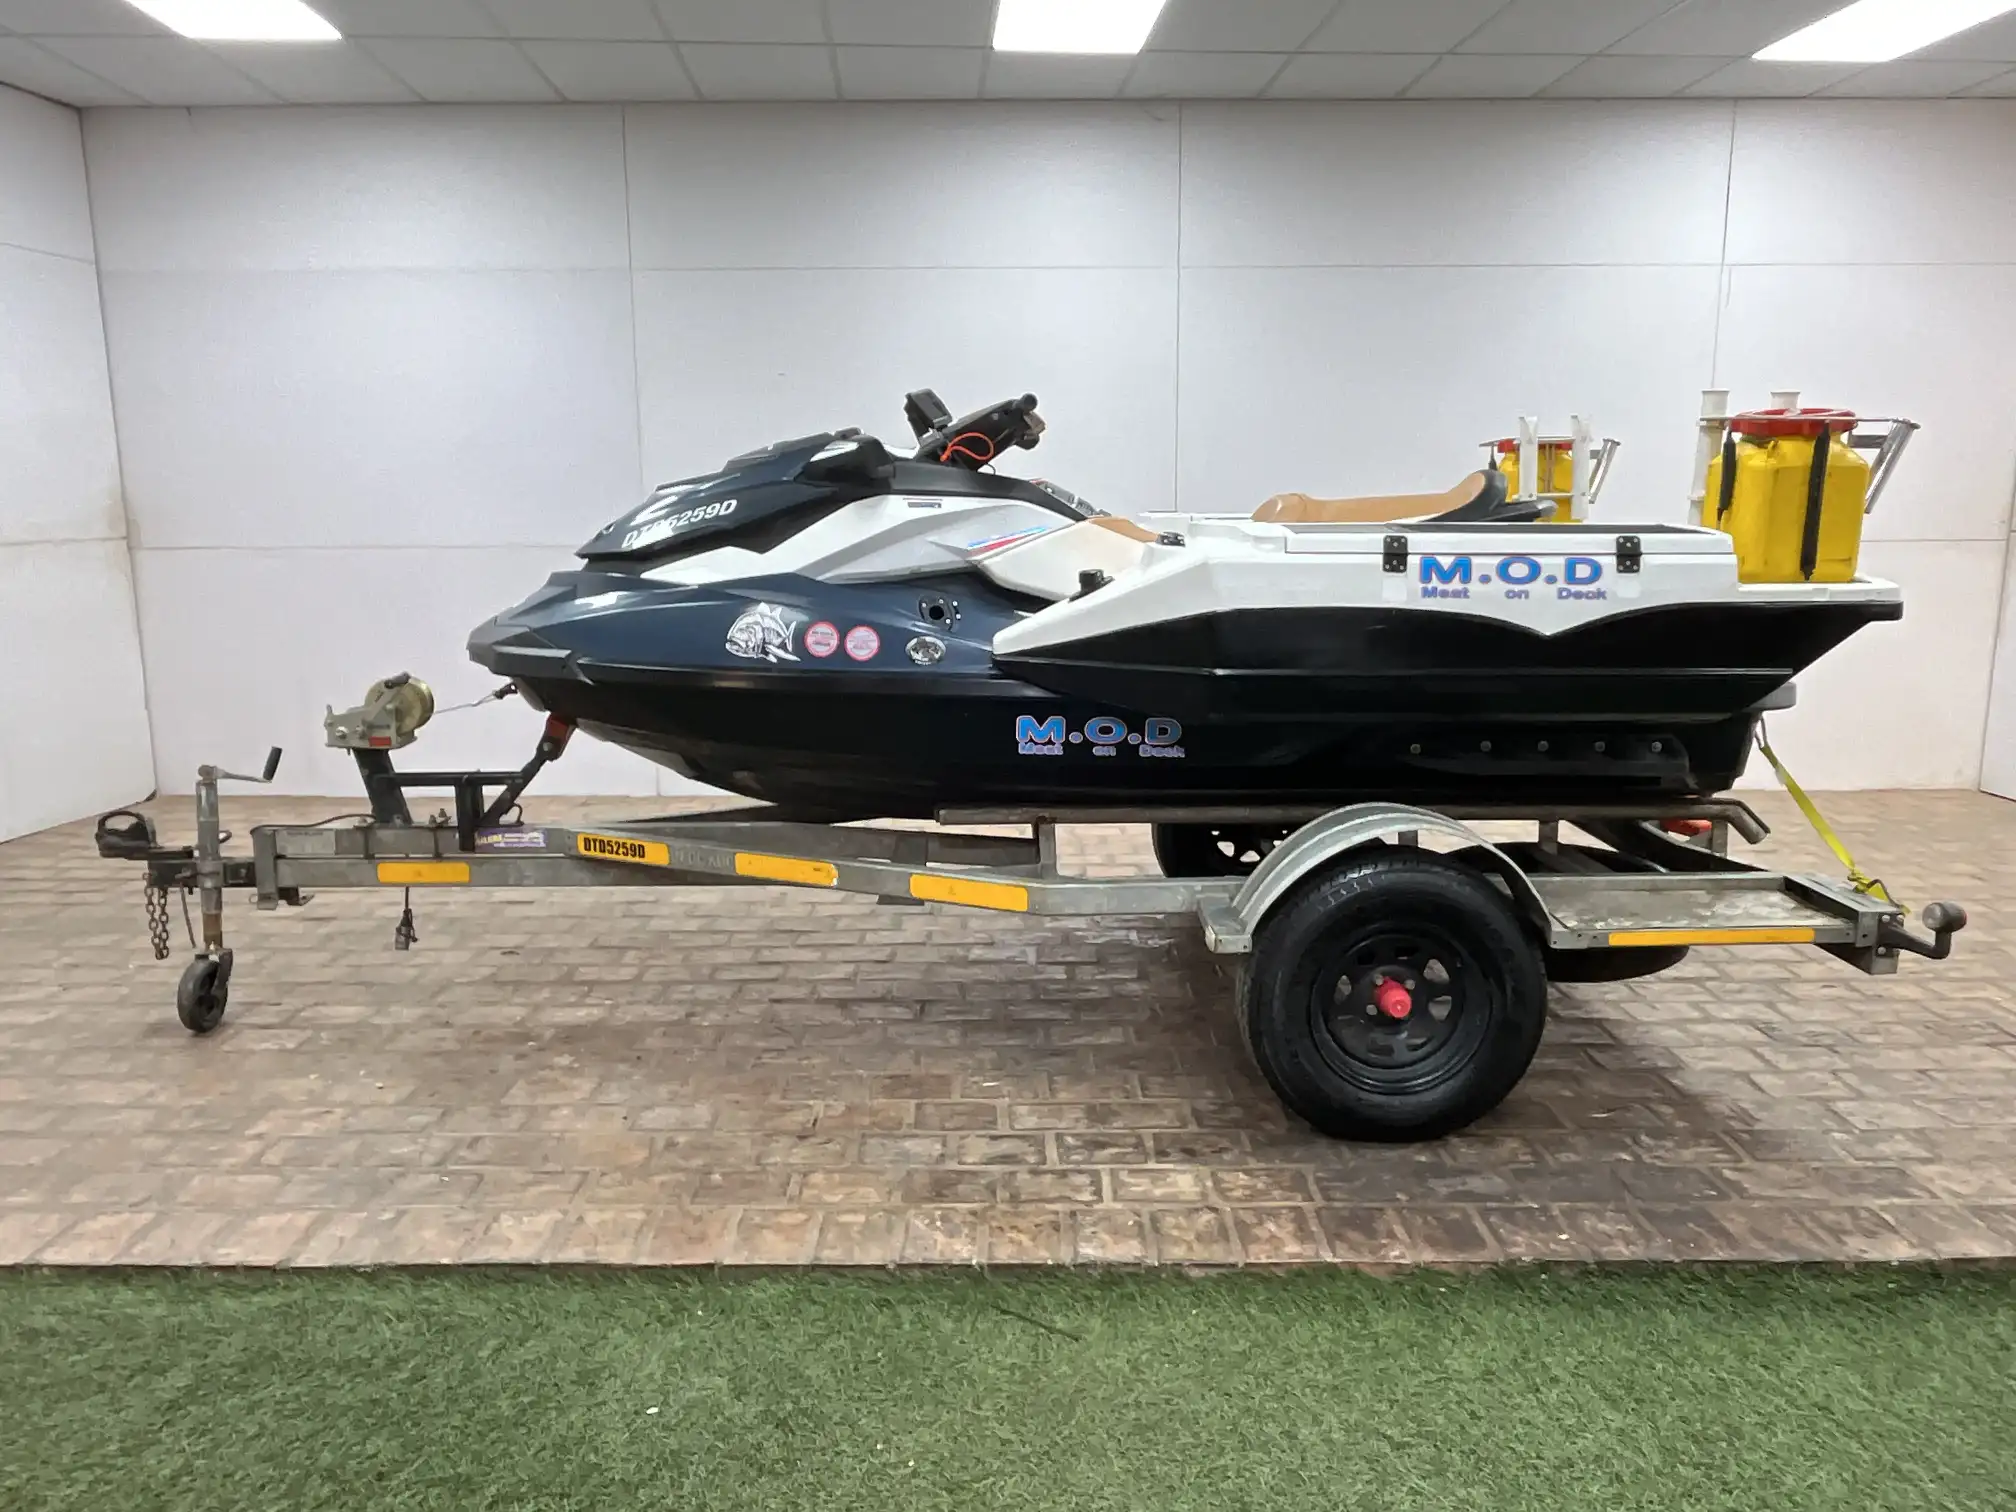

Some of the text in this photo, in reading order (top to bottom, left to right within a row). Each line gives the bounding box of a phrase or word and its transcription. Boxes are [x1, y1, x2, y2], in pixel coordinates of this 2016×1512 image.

[1419, 556, 1603, 585] M.O.D
[1421, 587, 1470, 599] Meat
[1505, 588, 1530, 600] on
[1016, 715, 1182, 745] M.O.D
[583, 837, 646, 859] DTD5259D
